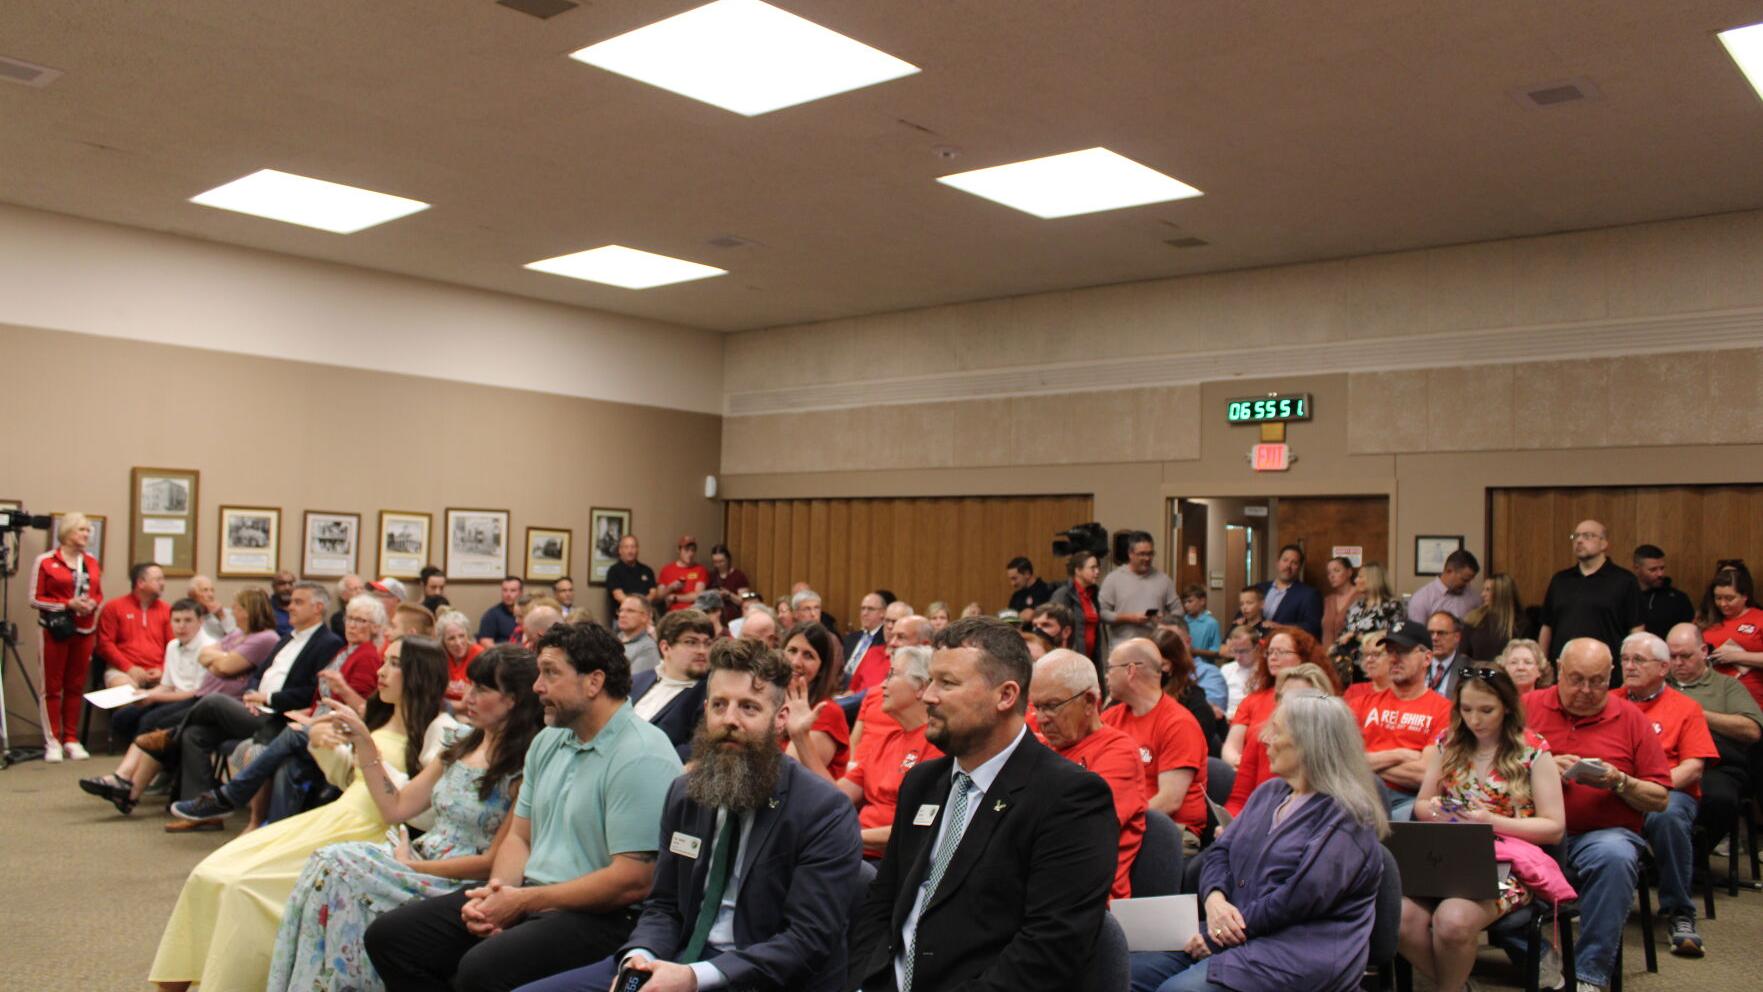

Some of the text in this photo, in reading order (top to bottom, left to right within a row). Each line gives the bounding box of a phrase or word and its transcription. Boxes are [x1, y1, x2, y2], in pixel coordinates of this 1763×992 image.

[1258, 446, 1283, 468] EXIT
[1364, 707, 1380, 728] A
[1401, 713, 1433, 728] SHIRT
